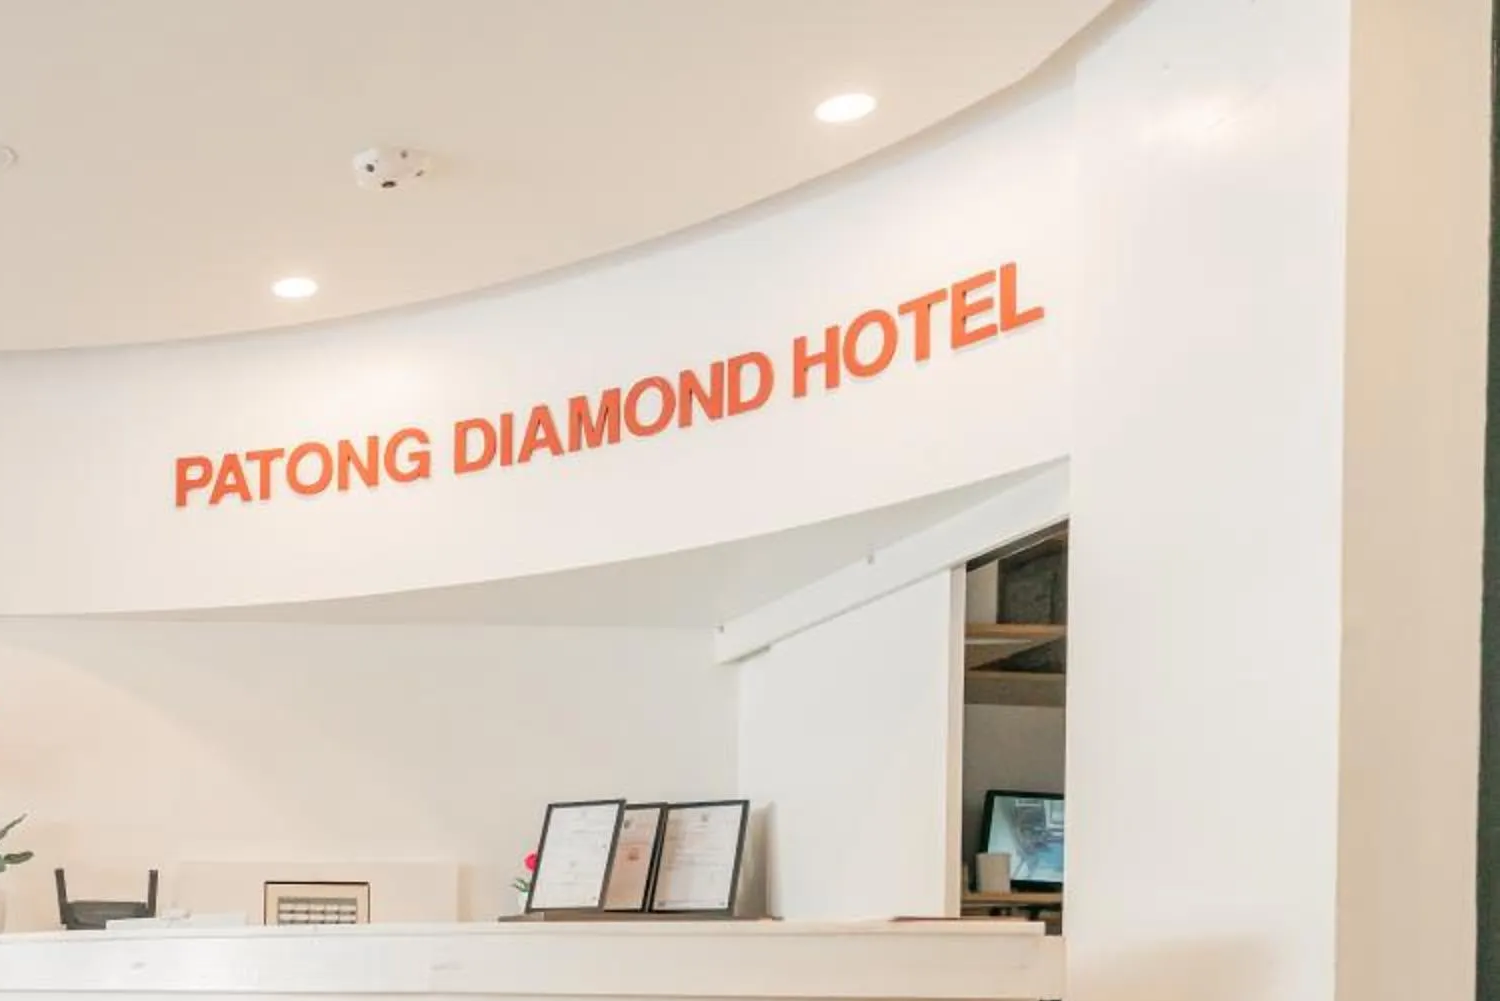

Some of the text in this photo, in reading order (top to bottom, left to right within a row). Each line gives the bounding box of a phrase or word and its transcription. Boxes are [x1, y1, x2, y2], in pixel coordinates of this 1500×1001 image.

[175, 262, 1045, 509] PATONG DIAMOND HOTEL
